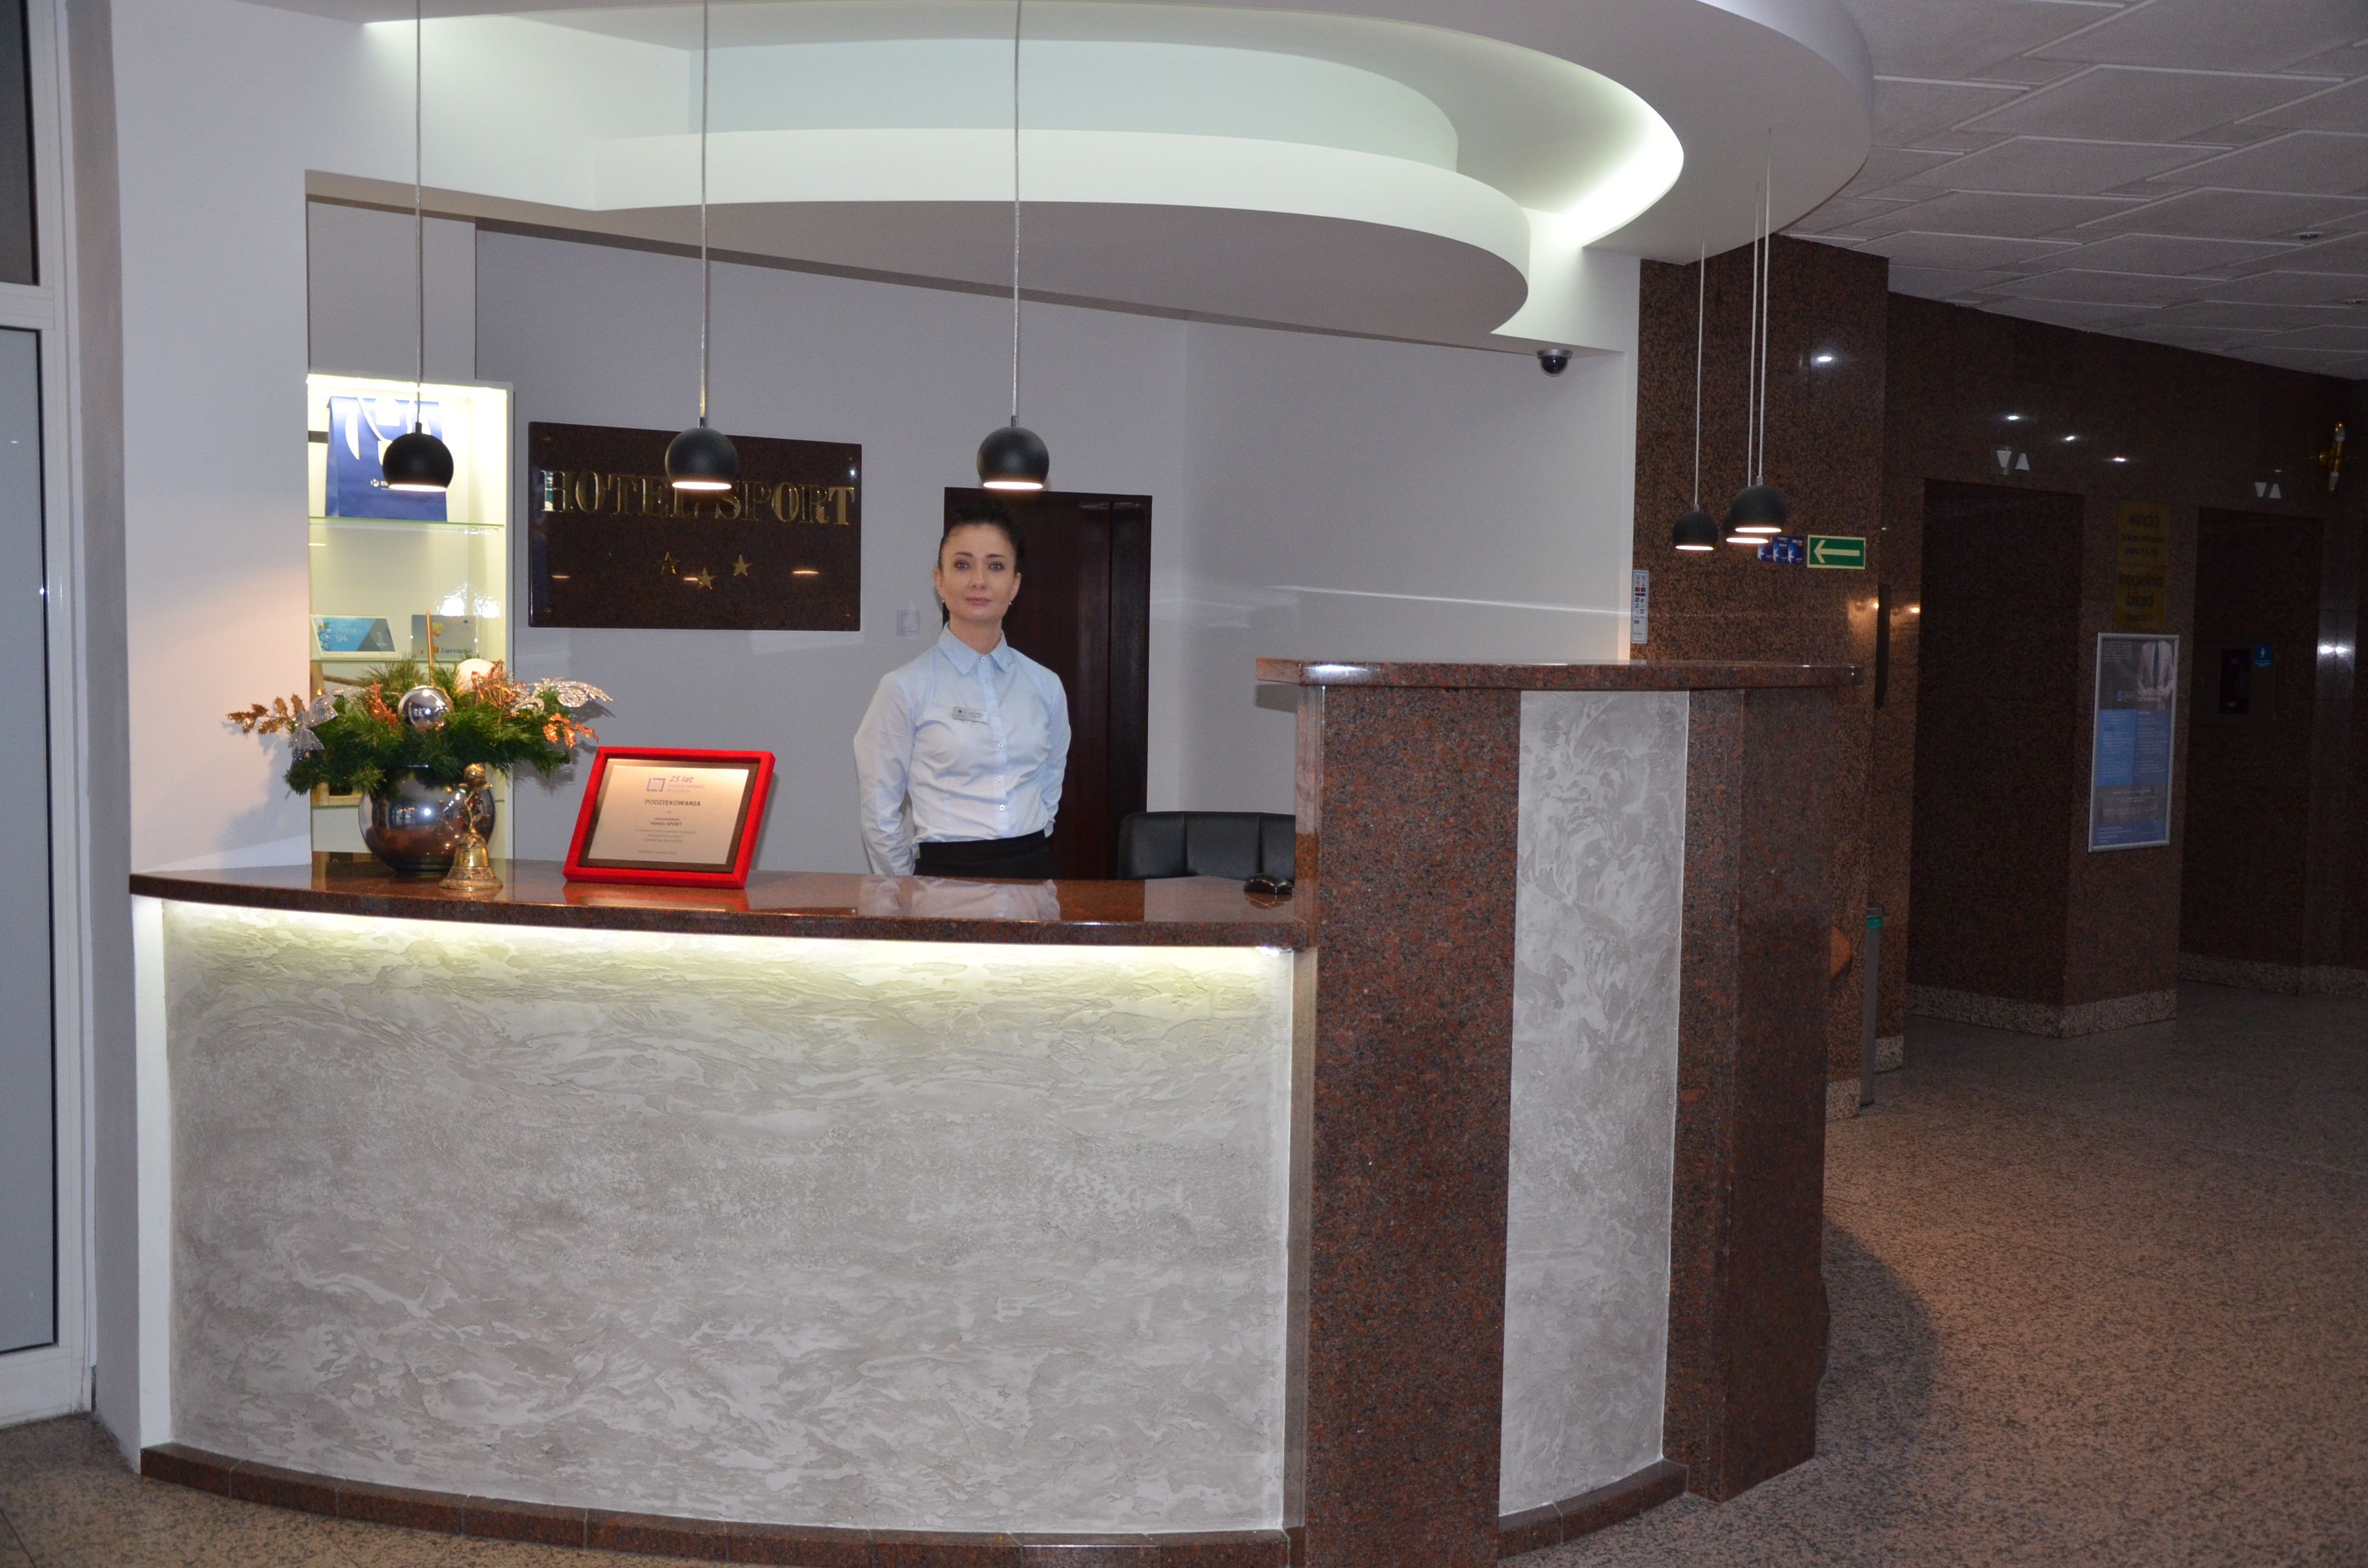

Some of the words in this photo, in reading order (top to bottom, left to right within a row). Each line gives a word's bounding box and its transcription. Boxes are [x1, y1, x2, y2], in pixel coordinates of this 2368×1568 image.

[541, 470, 698, 518] HOTEL
[715, 480, 855, 525] SPORT
[335, 635, 349, 643] SPA
